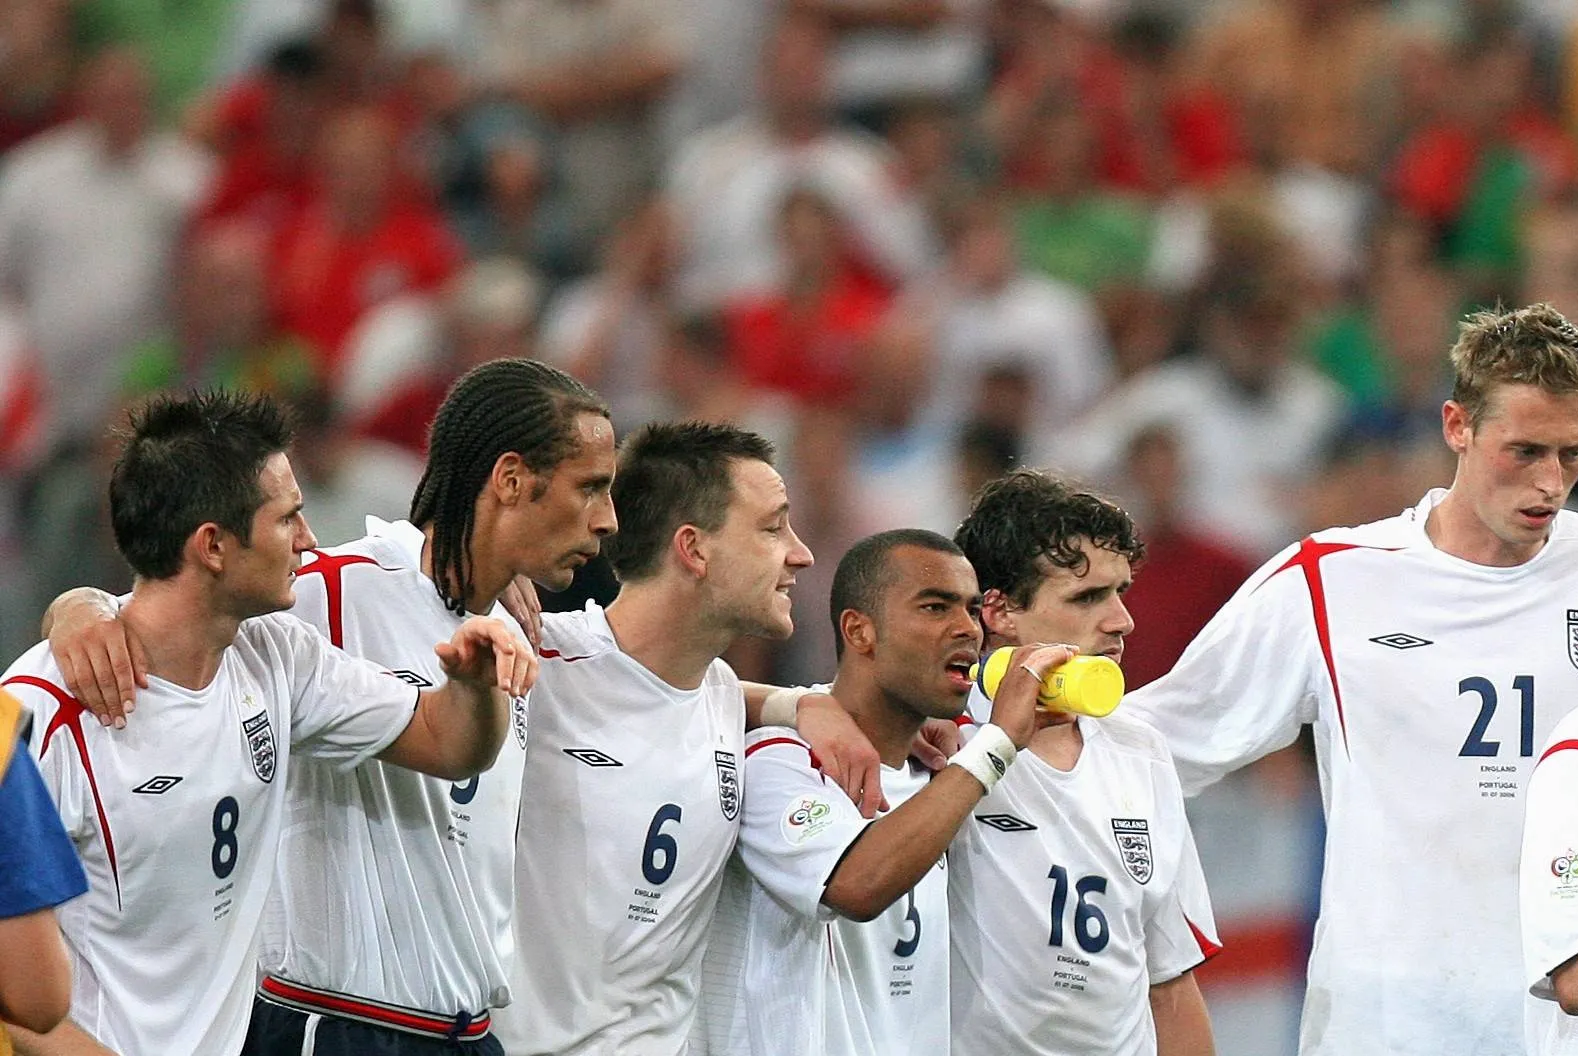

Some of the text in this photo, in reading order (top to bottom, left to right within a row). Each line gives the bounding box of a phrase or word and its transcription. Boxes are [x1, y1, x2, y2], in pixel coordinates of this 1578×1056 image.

[1457, 675, 1535, 757] 21
[211, 796, 239, 879] 8
[642, 804, 682, 886] 6
[1113, 820, 1148, 830] ENGLAND
[893, 888, 921, 958] 3
[1048, 864, 1110, 953] 16
[1053, 971, 1088, 983] PORTUGAL
[1056, 955, 1090, 967] ENGLAND
